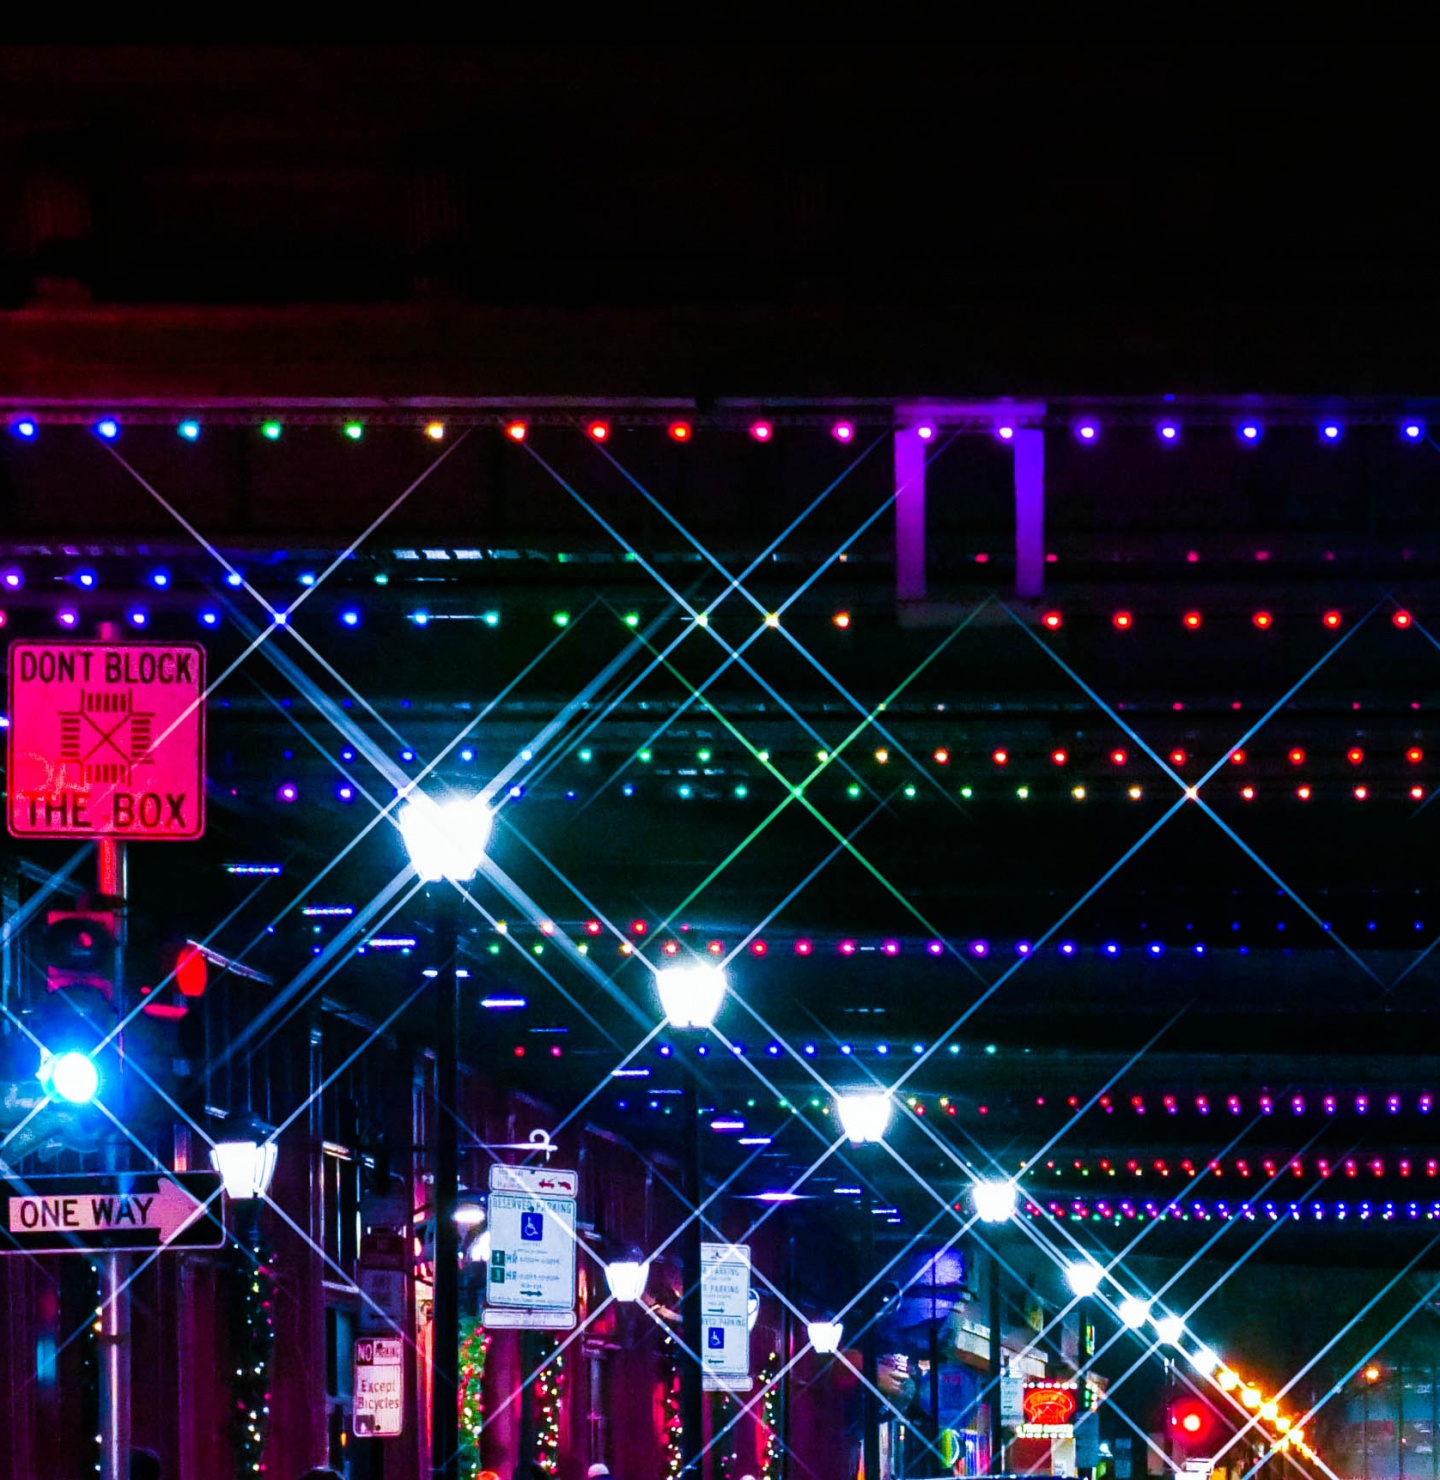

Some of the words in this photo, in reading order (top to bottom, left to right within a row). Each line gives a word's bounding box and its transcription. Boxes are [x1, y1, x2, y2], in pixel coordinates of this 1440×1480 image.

[105, 652, 192, 684] BLOCK
[24, 791, 92, 827] THE
[113, 792, 186, 828] BOX
[20, 1200, 79, 1228] ONE
[91, 1197, 154, 1225] WAY
[357, 1344, 373, 1361] NO
[361, 1380, 395, 1393] Except
[358, 1396, 400, 1410] Bicycles
